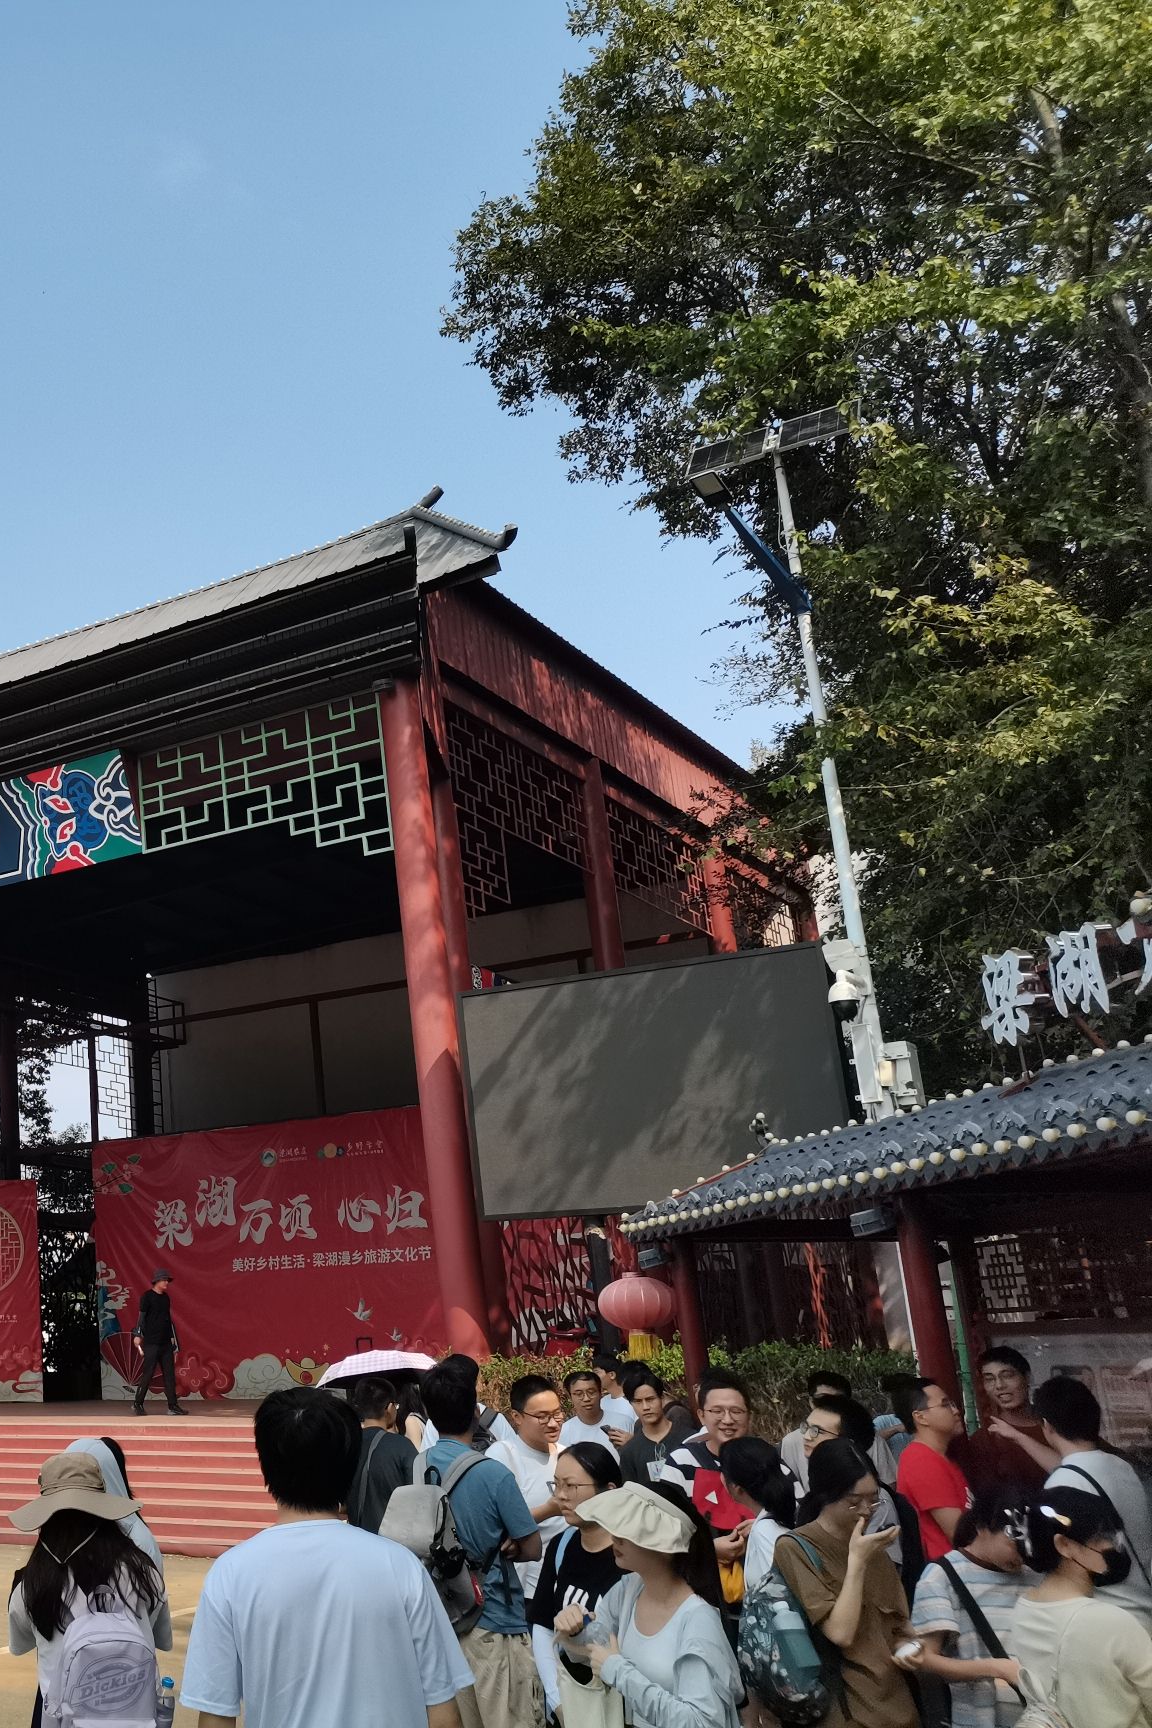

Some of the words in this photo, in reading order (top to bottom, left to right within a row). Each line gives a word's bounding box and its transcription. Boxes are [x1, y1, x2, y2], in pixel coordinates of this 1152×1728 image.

[154, 1175, 318, 1251] 梁湖万顷
[338, 1184, 428, 1236] 心归
[231, 1245, 432, 1273] 美好乡村生活·梁湖漫乡旅游文化节
[80, 1668, 146, 1699] Dickies
